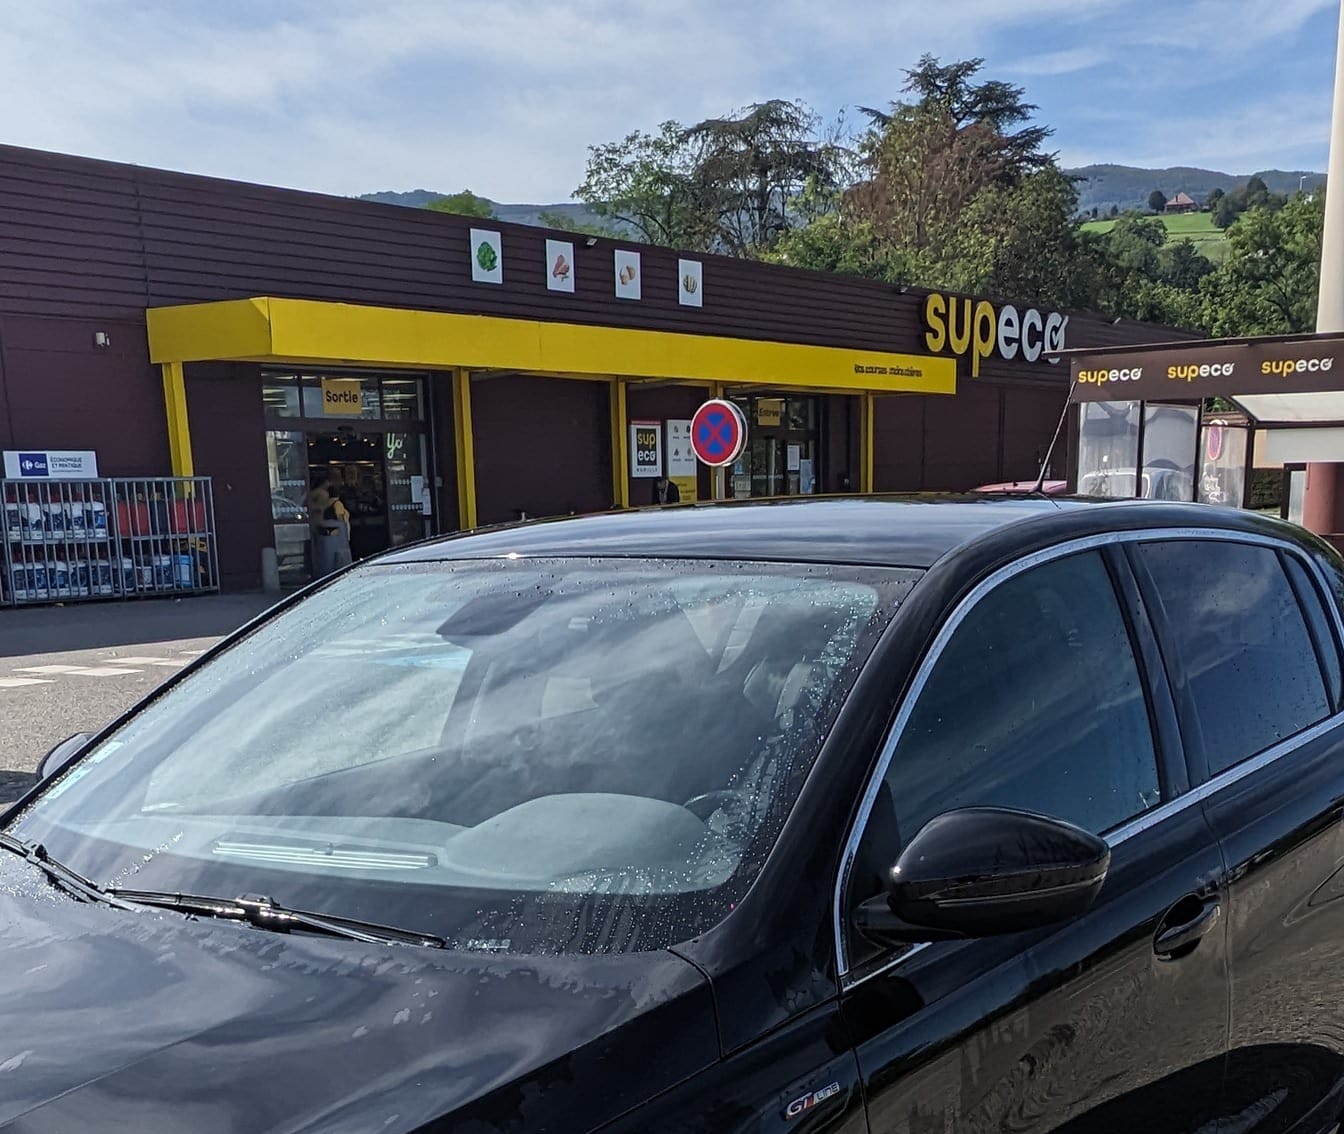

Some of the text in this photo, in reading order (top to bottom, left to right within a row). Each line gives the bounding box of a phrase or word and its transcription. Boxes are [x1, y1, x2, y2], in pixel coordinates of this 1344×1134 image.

[925, 293, 1069, 378] supeco
[1167, 362, 1235, 382] supeco
[1261, 356, 1335, 377] supeco
[1077, 367, 1144, 387] supeco
[325, 390, 359, 404] Sortie
[637, 432, 656, 450] sup
[637, 450, 656, 461] eco
